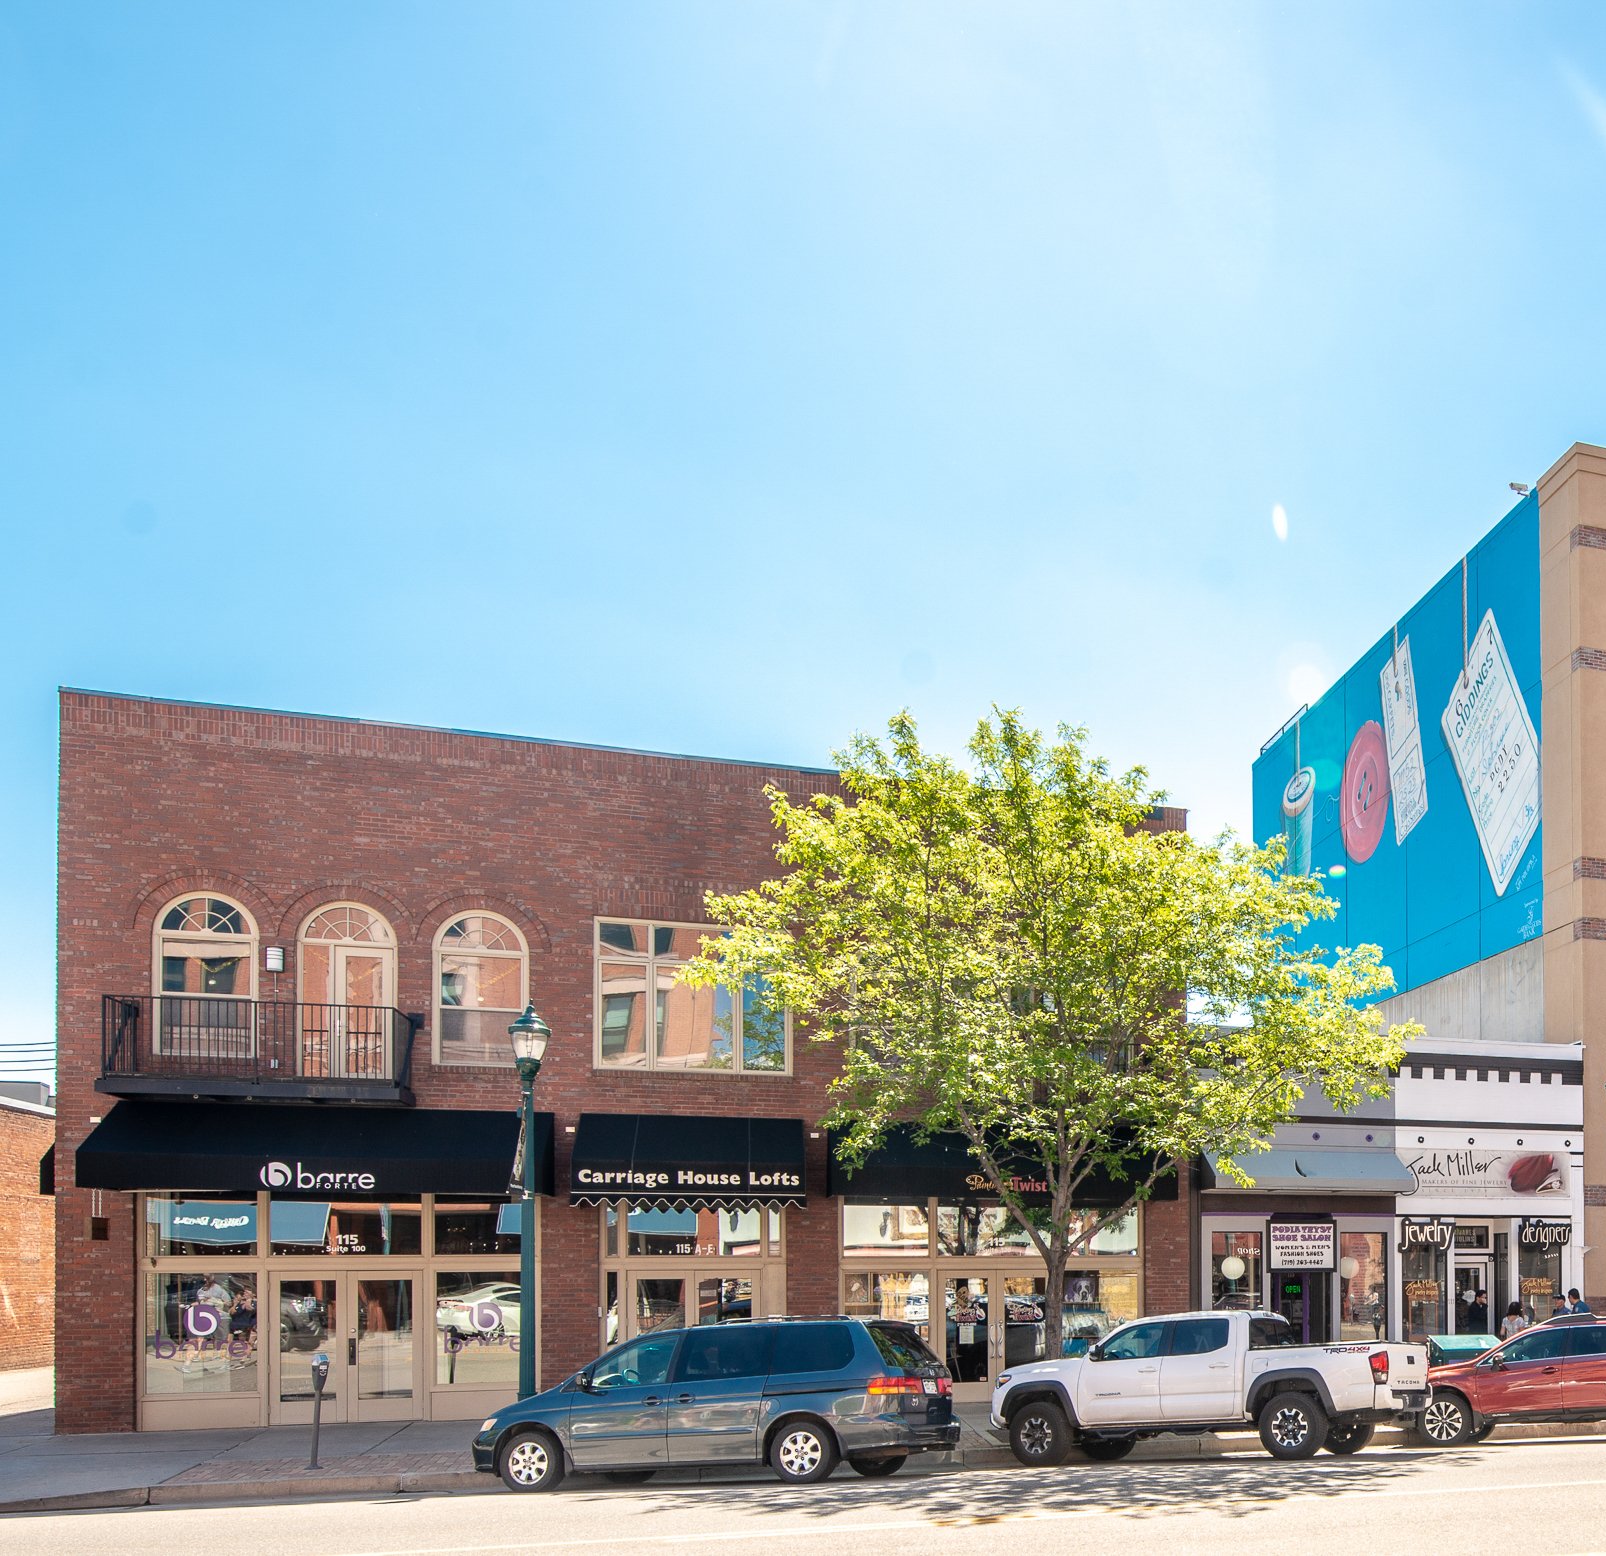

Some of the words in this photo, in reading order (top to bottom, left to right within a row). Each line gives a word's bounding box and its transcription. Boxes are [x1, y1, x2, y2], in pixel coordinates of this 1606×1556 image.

[1455, 651, 1494, 738] GIDDINGS
[1446, 1151, 1501, 1176] Miller
[297, 1162, 375, 1189] barre
[578, 1169, 669, 1188] Carriage
[677, 1170, 740, 1185] House
[749, 1171, 800, 1186] Lofts
[1010, 1176, 1047, 1192] Twist
[336, 1234, 358, 1245] 115
[1272, 1234, 1298, 1242] SHOE
[1300, 1234, 1331, 1242] SALON
[1402, 1220, 1452, 1250] jewelry
[1522, 1221, 1570, 1250] designers
[326, 1245, 348, 1254] Suite
[676, 1244, 690, 1253] 115
[1285, 1285, 1301, 1294] OPEN
[155, 1330, 248, 1360] barre
